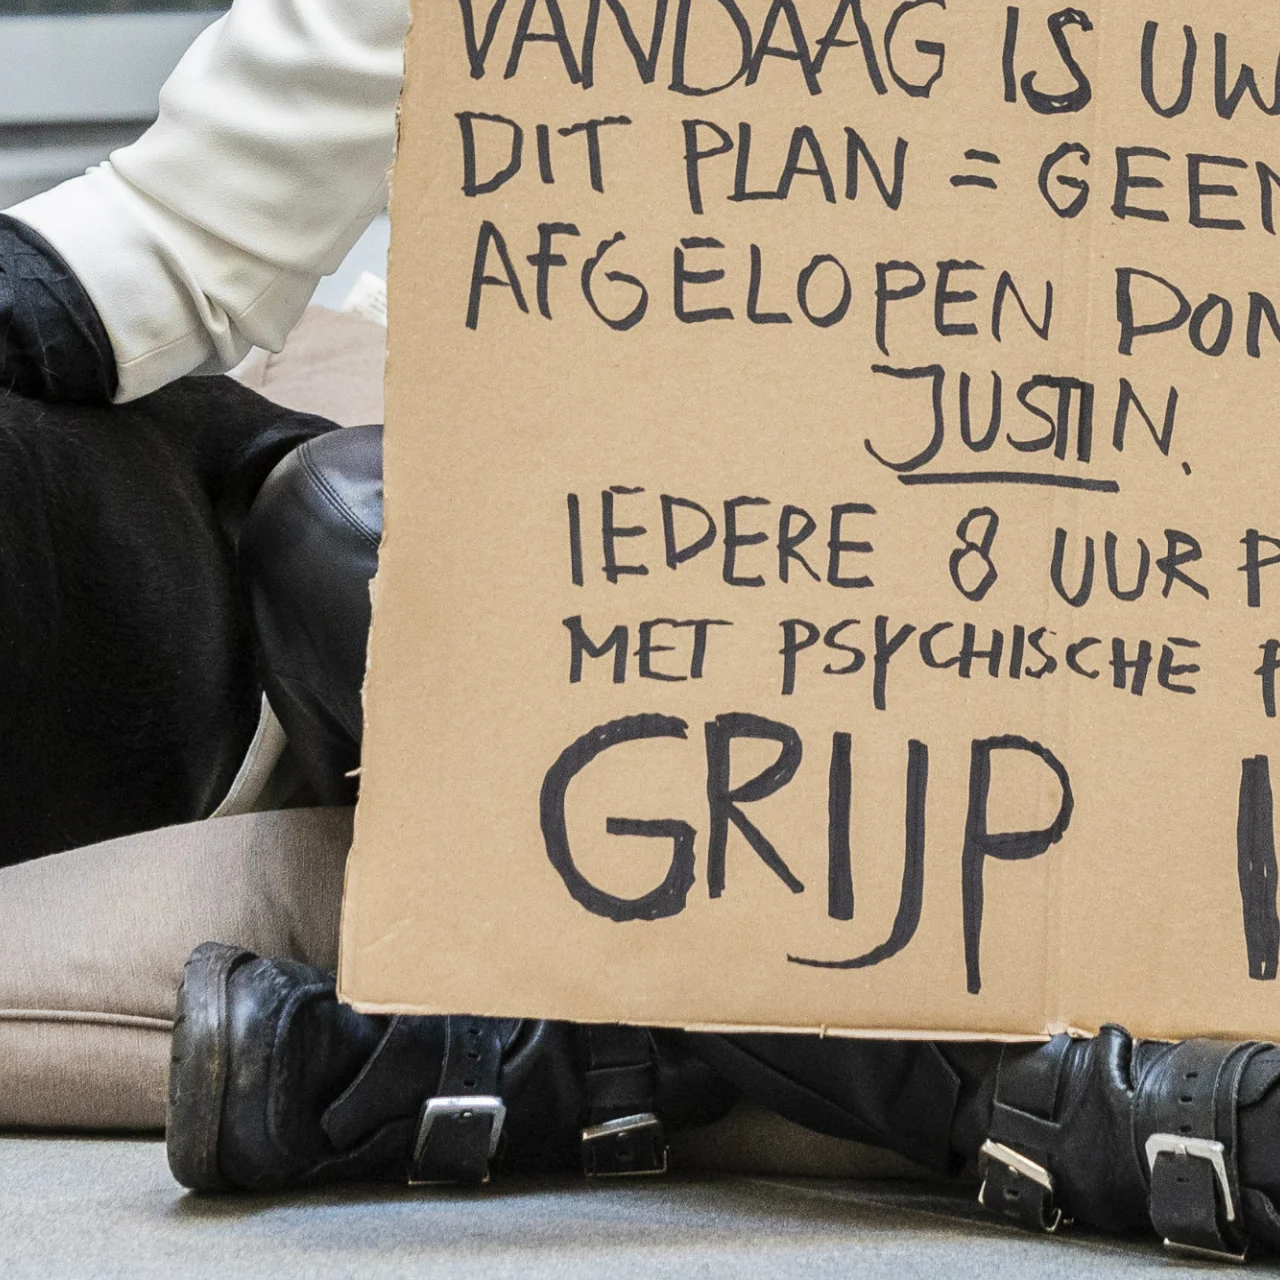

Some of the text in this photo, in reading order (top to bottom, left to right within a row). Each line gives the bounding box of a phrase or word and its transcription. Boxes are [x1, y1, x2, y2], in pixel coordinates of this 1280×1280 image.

[1002, 6, 1093, 114] IS
[455, 111, 631, 197] DIT
[682, 120, 908, 214] PLAN
[466, 221, 1052, 356] AFGELOPEN
[567, 486, 876, 588] IEDERE
[949, 507, 998, 601] 8
[1051, 528, 1209, 607] UUR
[562, 616, 732, 683] MET
[779, 616, 1200, 710] PSYCHISCHE
[540, 712, 1074, 994] GRIJP
